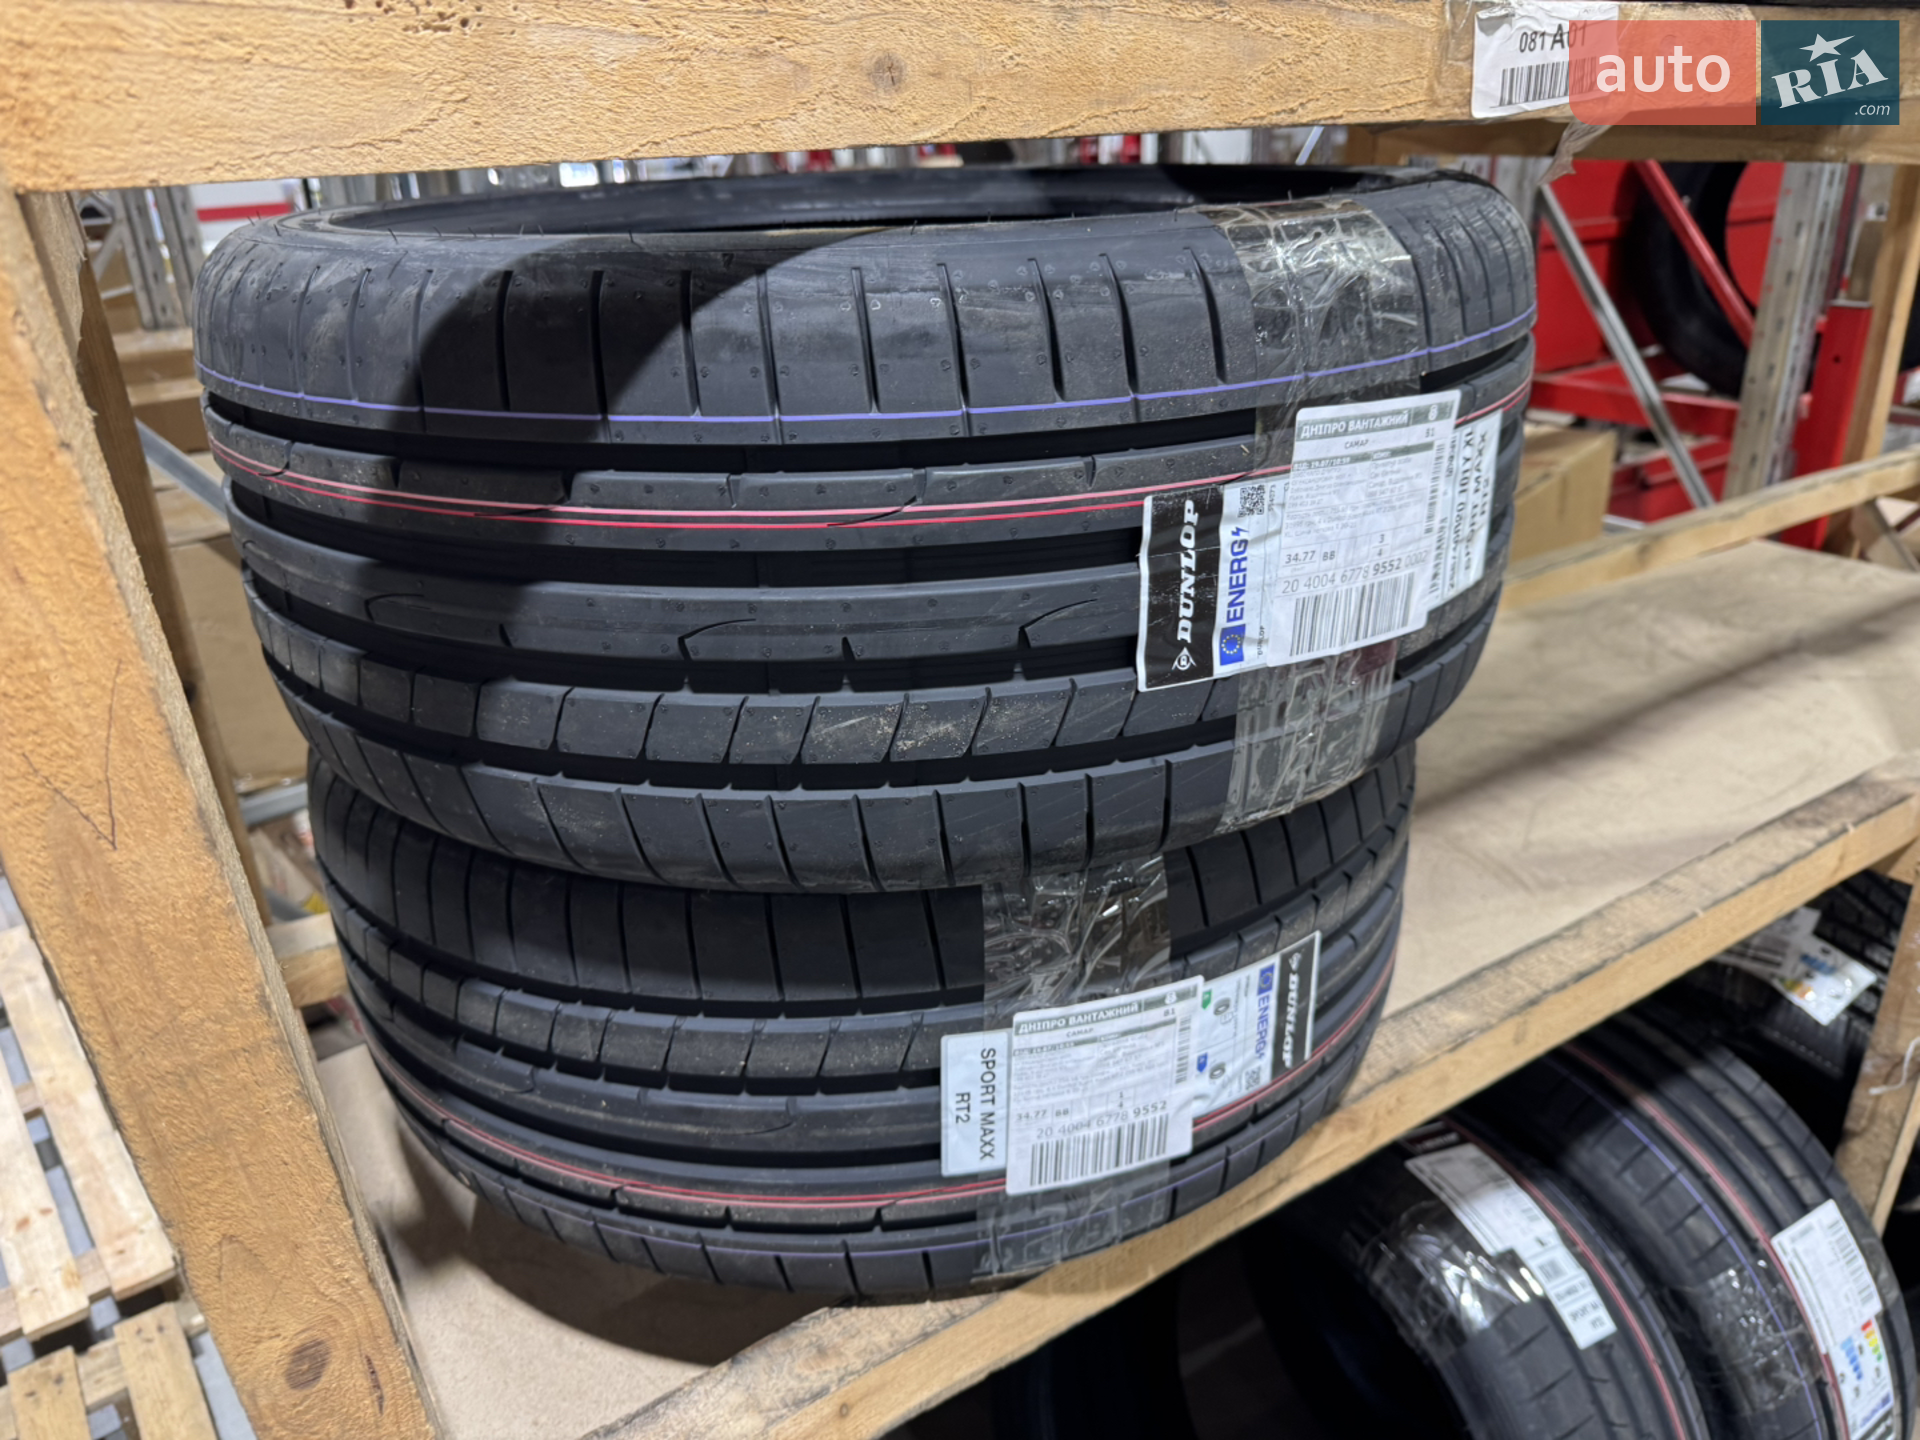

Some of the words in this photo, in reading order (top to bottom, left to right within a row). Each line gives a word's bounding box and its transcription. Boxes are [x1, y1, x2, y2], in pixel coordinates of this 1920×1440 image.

[1518, 31, 1546, 53] 081
[1300, 421, 1345, 440] ДНІПРО
[1348, 410, 1409, 431] ВАНТАЖНИЙ
[1473, 431, 1488, 495] MAXX
[1177, 500, 1198, 643] DUNLOP
[1282, 579, 1299, 594] 20
[1303, 572, 1336, 590] 4004
[1340, 565, 1370, 584] 6778
[1373, 557, 1402, 576] 9552
[1285, 550, 1316, 564] 34.77
[1019, 1015, 1066, 1035] ДНІПРО
[1068, 1002, 1139, 1025] ВАНТАЖНИЙ
[1282, 972, 1299, 1069] DUNLOP
[979, 1047, 996, 1107] SPORT
[955, 1091, 971, 1124] RT2
[1016, 1109, 1047, 1122] 34.77
[1036, 1127, 1053, 1140] 20
[1058, 1120, 1092, 1135] 4004
[1096, 1111, 1129, 1127] 6778
[1132, 1101, 1168, 1118] 9552
[979, 1111, 996, 1161] MAXX
